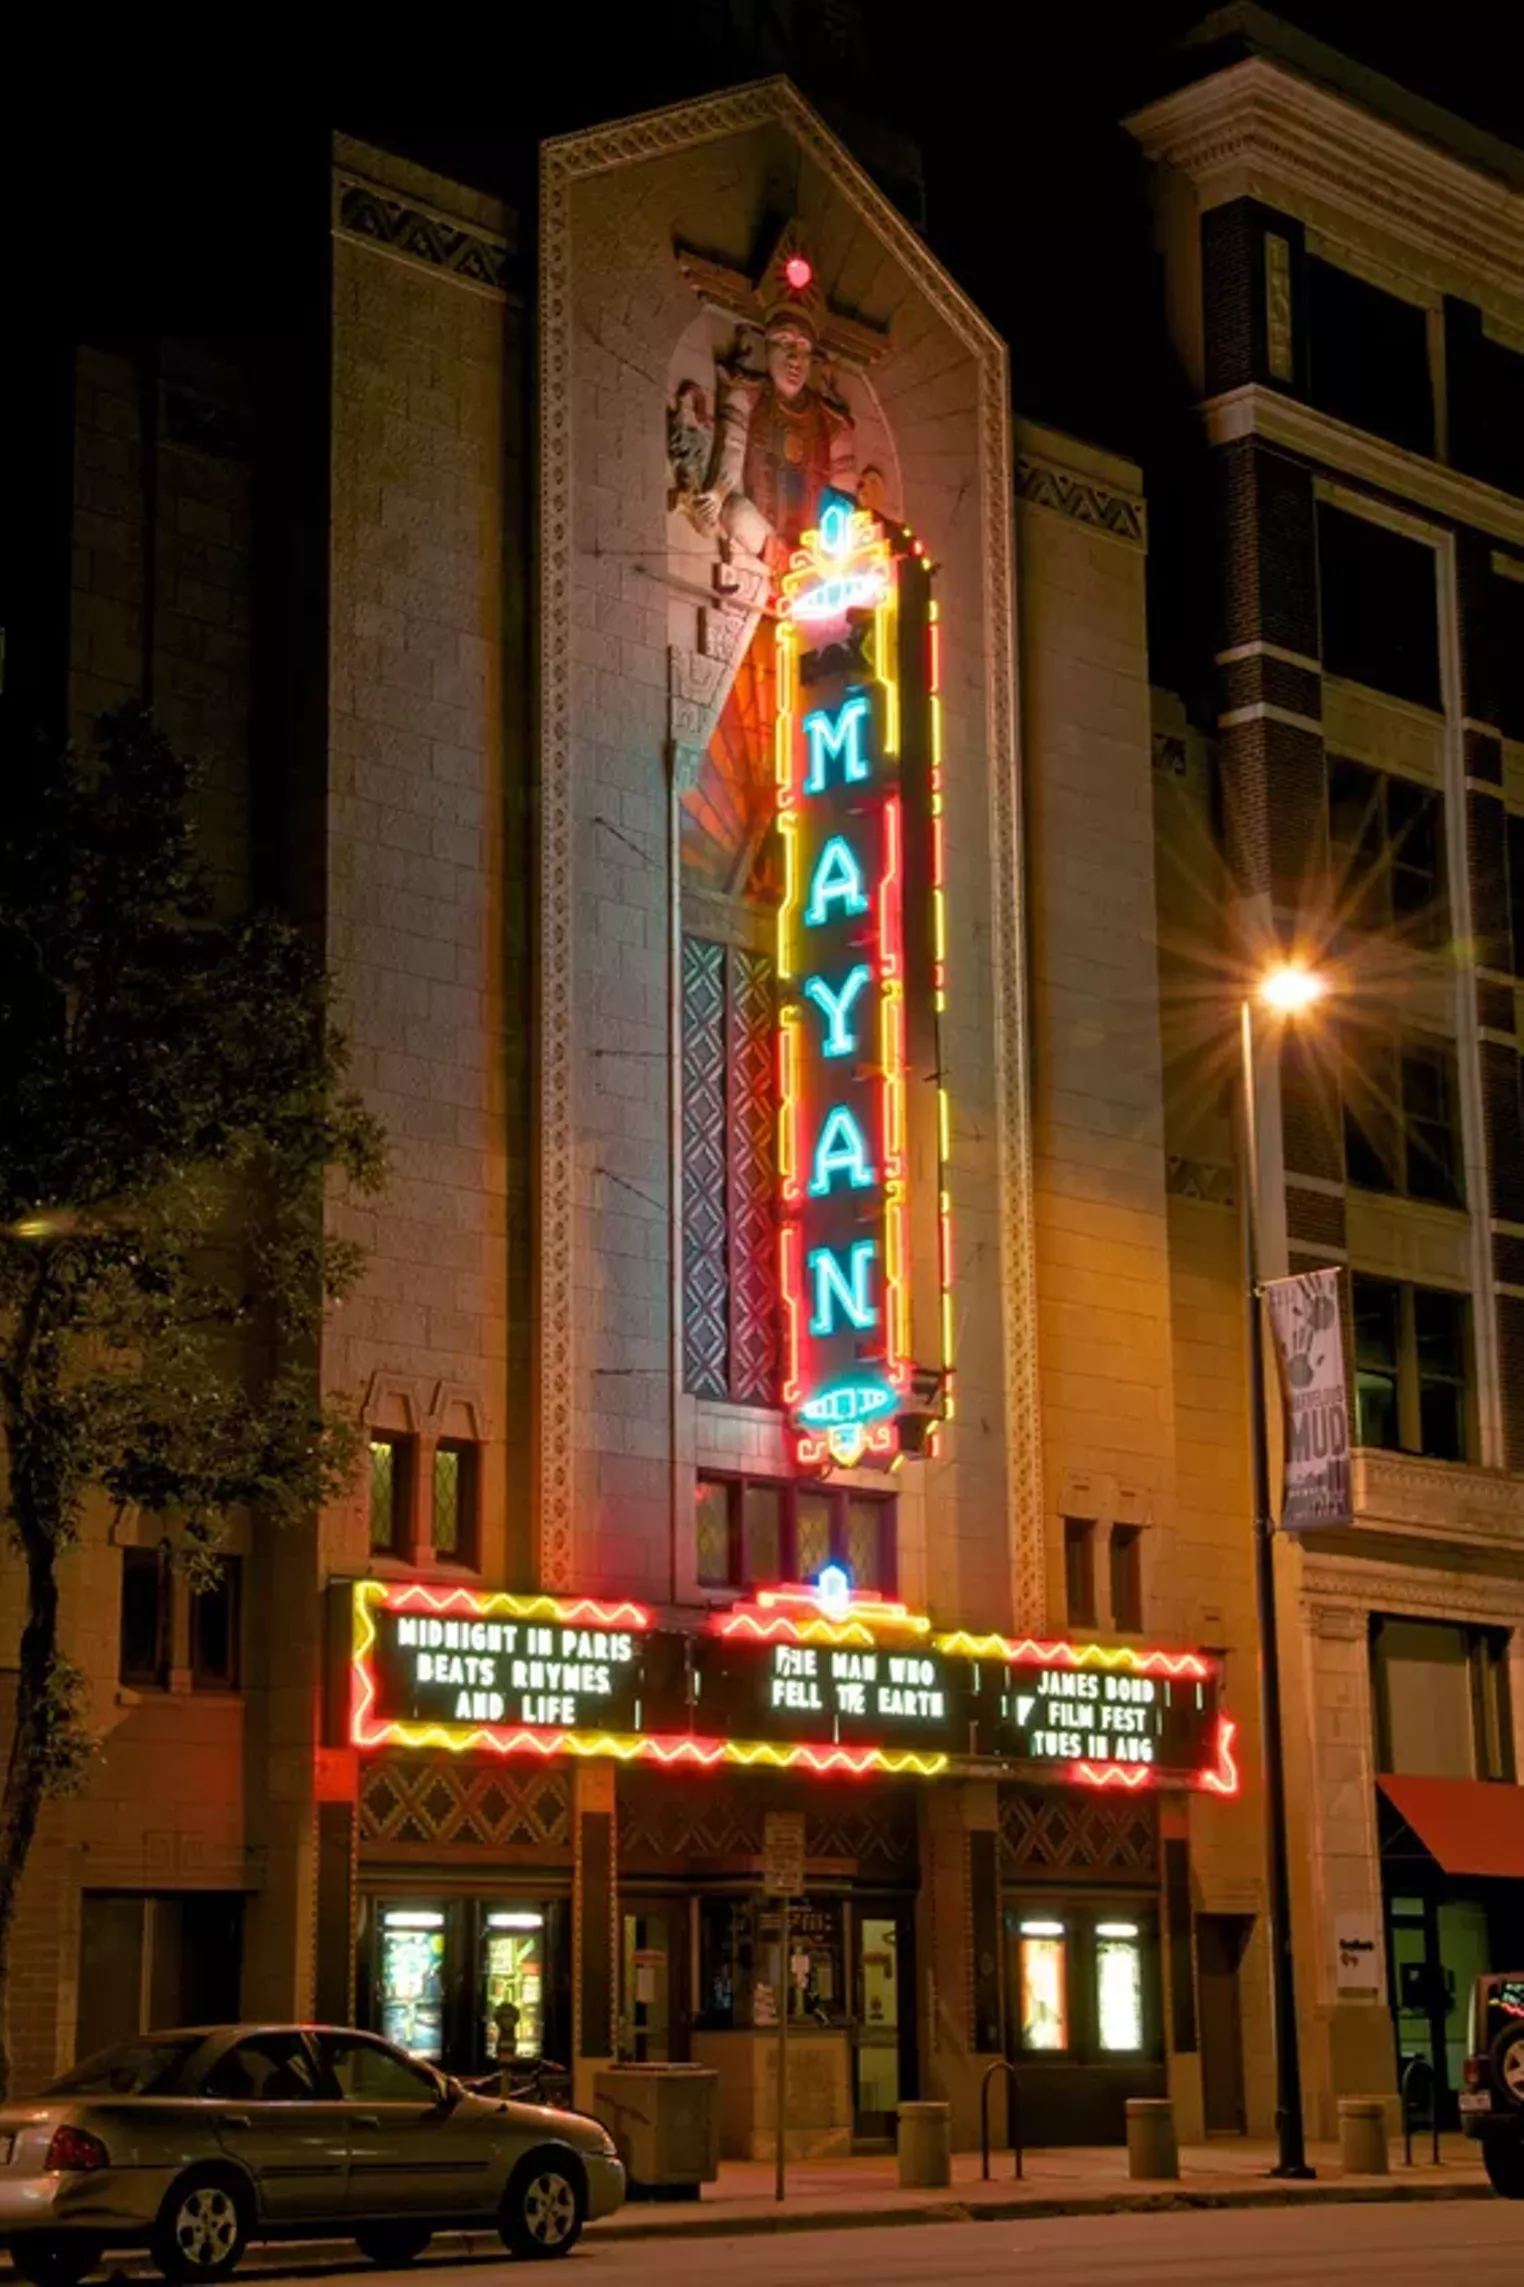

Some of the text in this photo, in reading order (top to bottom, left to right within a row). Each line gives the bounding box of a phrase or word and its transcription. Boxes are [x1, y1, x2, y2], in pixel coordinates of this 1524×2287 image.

[802, 694, 878, 1338] MAYAN
[397, 1617, 632, 1663] MIDNIGHT IN PARIS
[416, 1653, 611, 1694] BEATS RHYMES
[831, 1652, 877, 1681] MAN
[888, 1657, 935, 1687] WHO
[1037, 1670, 1155, 1702] JAMES BOND
[455, 1690, 575, 1724] AND LIFE
[772, 1679, 822, 1709] FELL
[878, 1686, 944, 1717] EARTH
[1048, 1701, 1147, 1732] FILM FEST
[1033, 1731, 1153, 1762] TUES IN AUG
